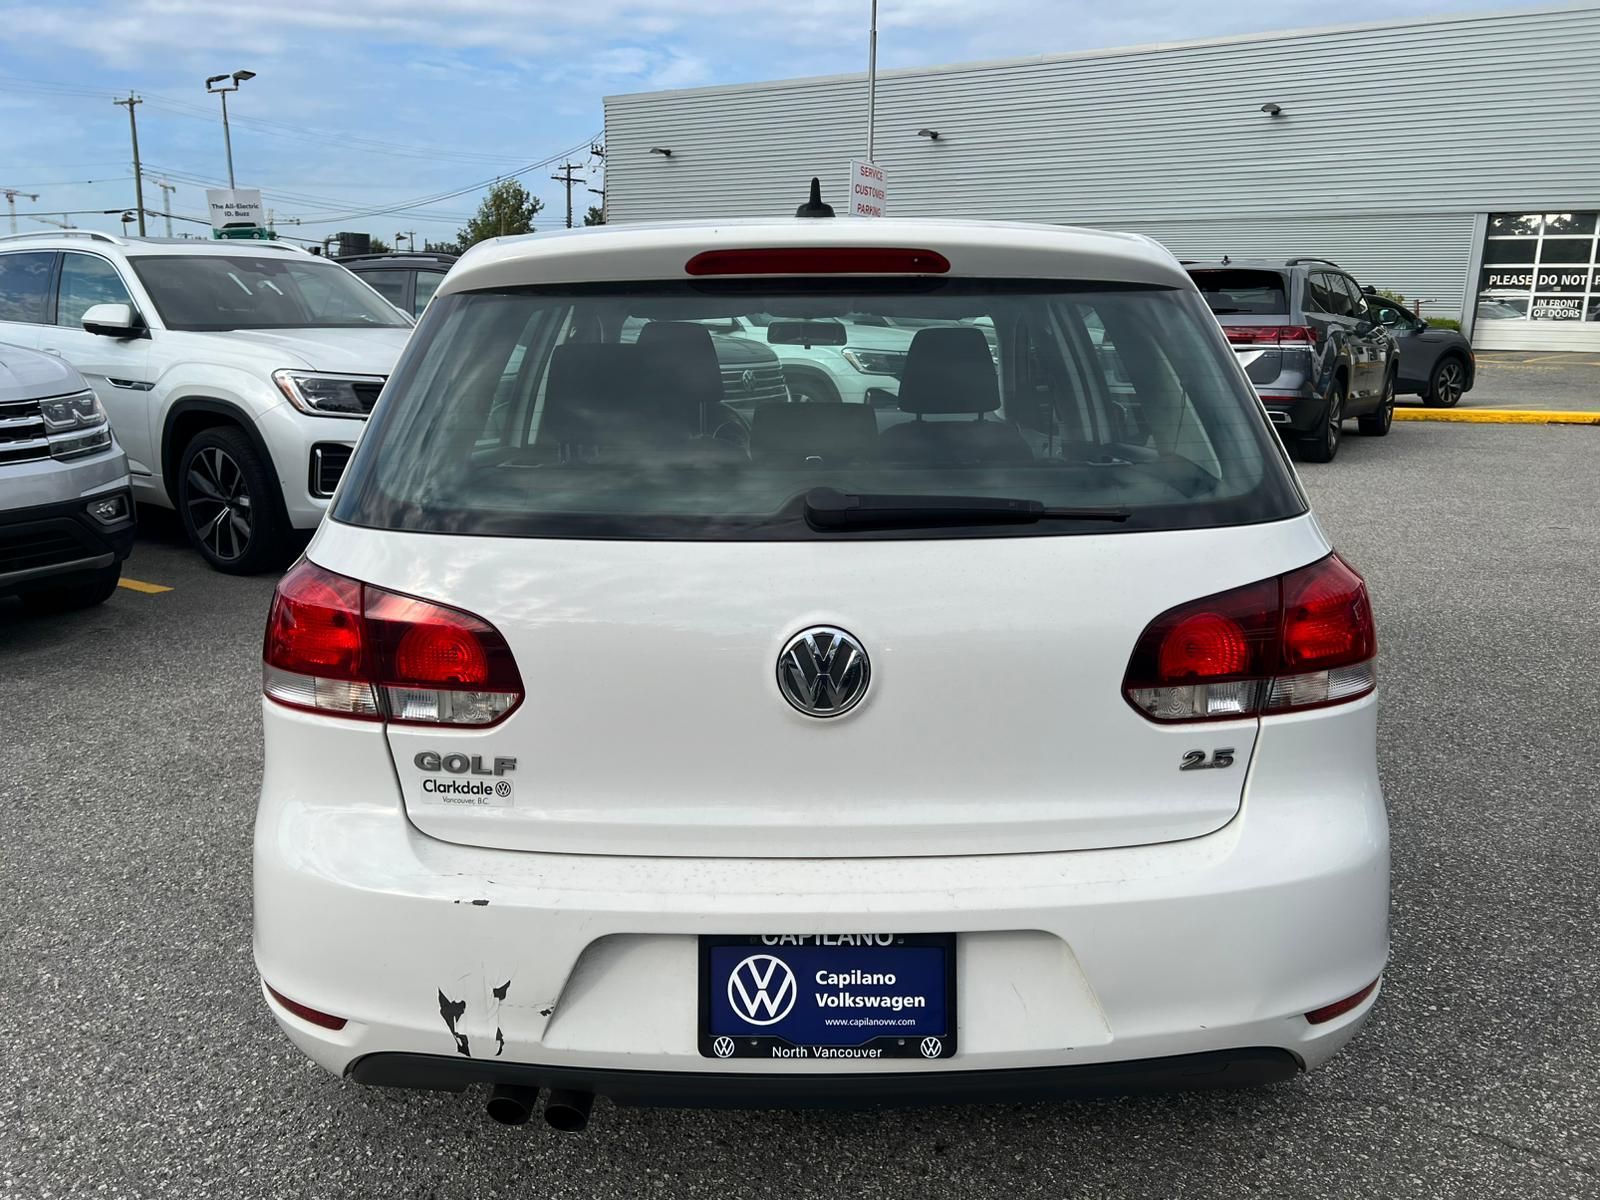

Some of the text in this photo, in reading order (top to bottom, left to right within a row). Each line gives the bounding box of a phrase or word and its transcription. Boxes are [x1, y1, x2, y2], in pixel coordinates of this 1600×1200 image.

[860, 166, 883, 181] SERVICE
[855, 184, 884, 200] CUSTOMER
[1489, 274, 1532, 285] PLEASE
[1538, 274, 1558, 285] DO
[1561, 274, 1588, 285] NOT
[1536, 300, 1580, 308] IN FRONT
[1533, 309, 1580, 318] OF DOORS
[414, 751, 517, 776] GOLF
[422, 779, 493, 795] Clarkdale
[815, 970, 896, 988] Capilano
[815, 993, 926, 1011] Volkswagen
[825, 1017, 916, 1027] www.capilanovw.com
[772, 1047, 882, 1058] North Vancouver
